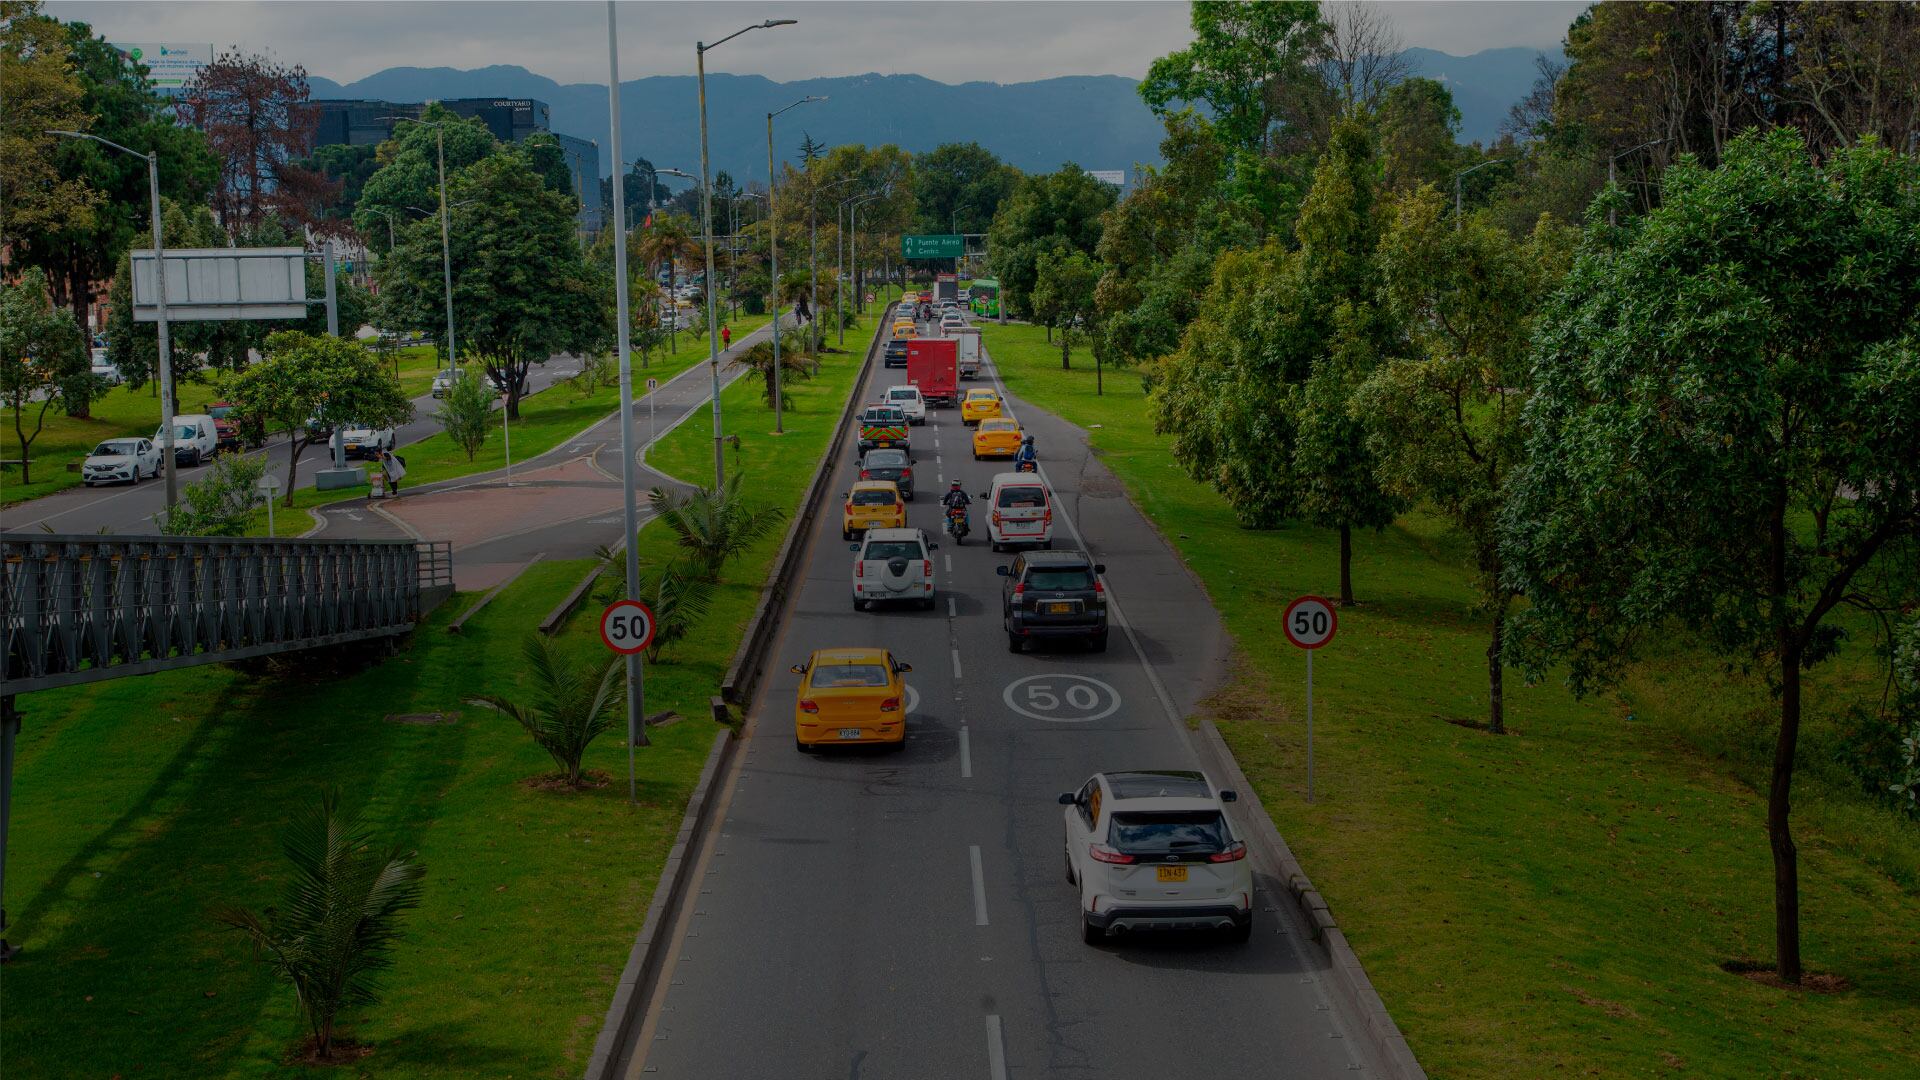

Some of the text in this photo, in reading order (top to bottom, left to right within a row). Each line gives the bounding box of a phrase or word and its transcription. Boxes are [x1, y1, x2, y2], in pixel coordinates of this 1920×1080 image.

[612, 615, 645, 639] 50
[1295, 611, 1327, 635] 50
[1028, 684, 1099, 710] 50
